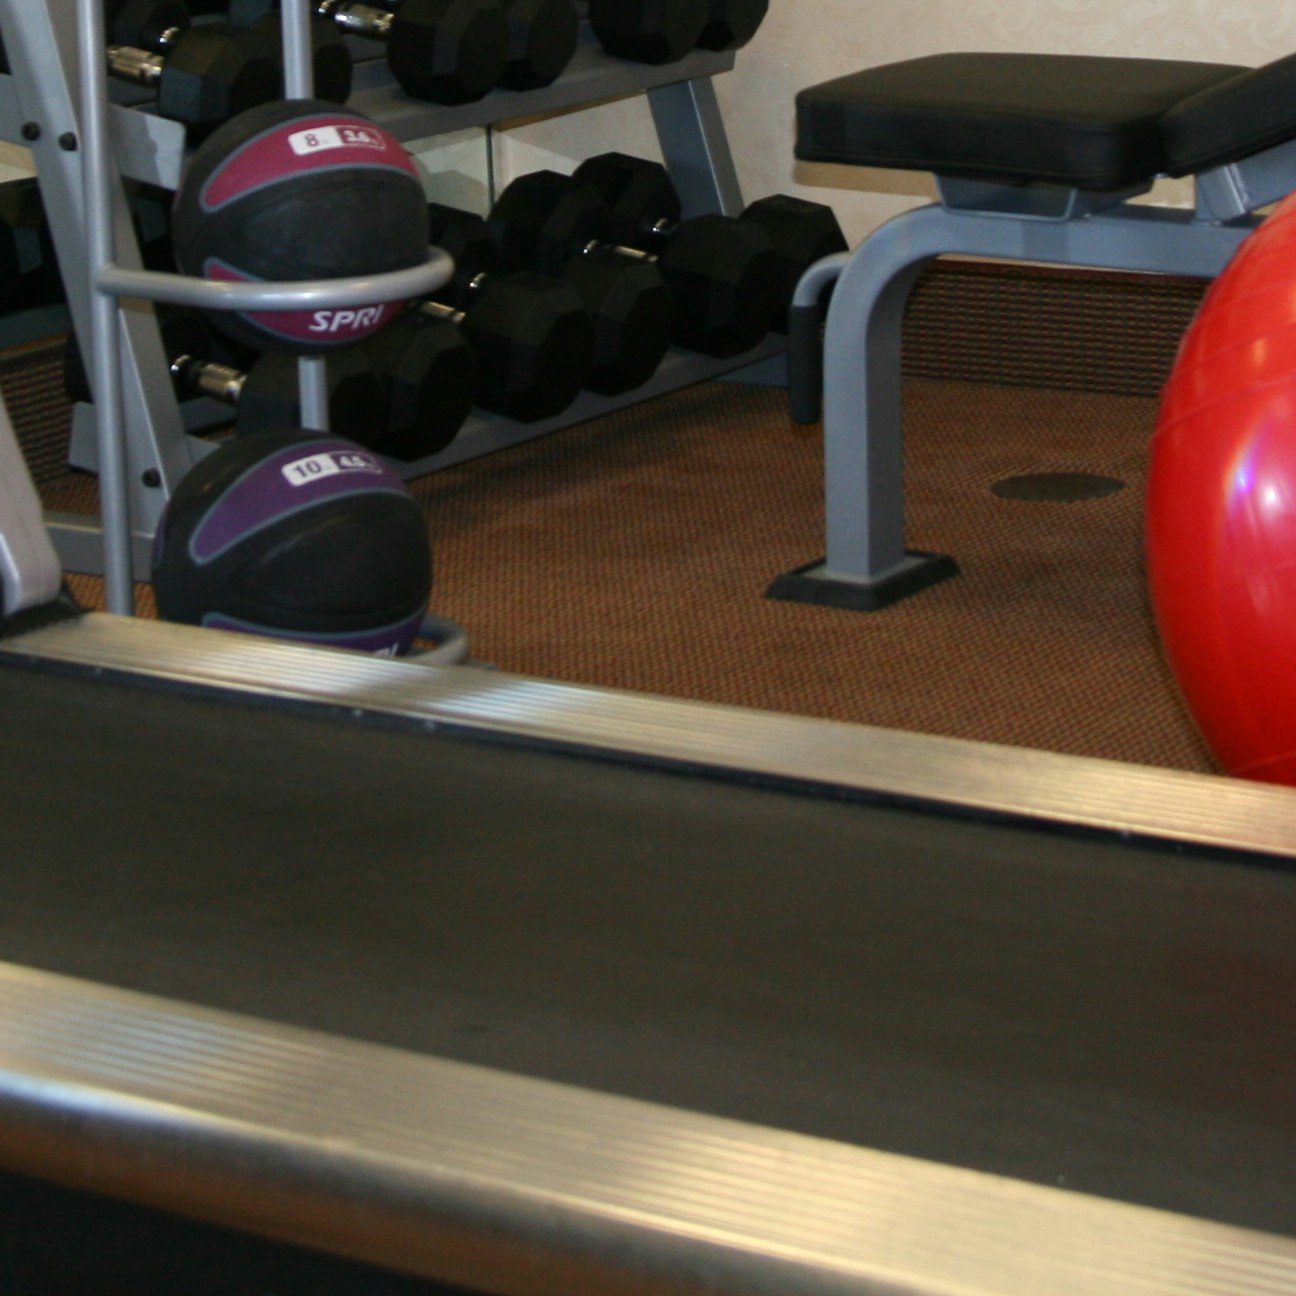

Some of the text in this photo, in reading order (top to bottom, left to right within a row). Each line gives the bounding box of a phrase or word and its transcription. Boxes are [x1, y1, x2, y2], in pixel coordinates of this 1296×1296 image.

[304, 133, 319, 147] 8
[308, 304, 384, 332] SPRI
[293, 460, 322, 478] 10
